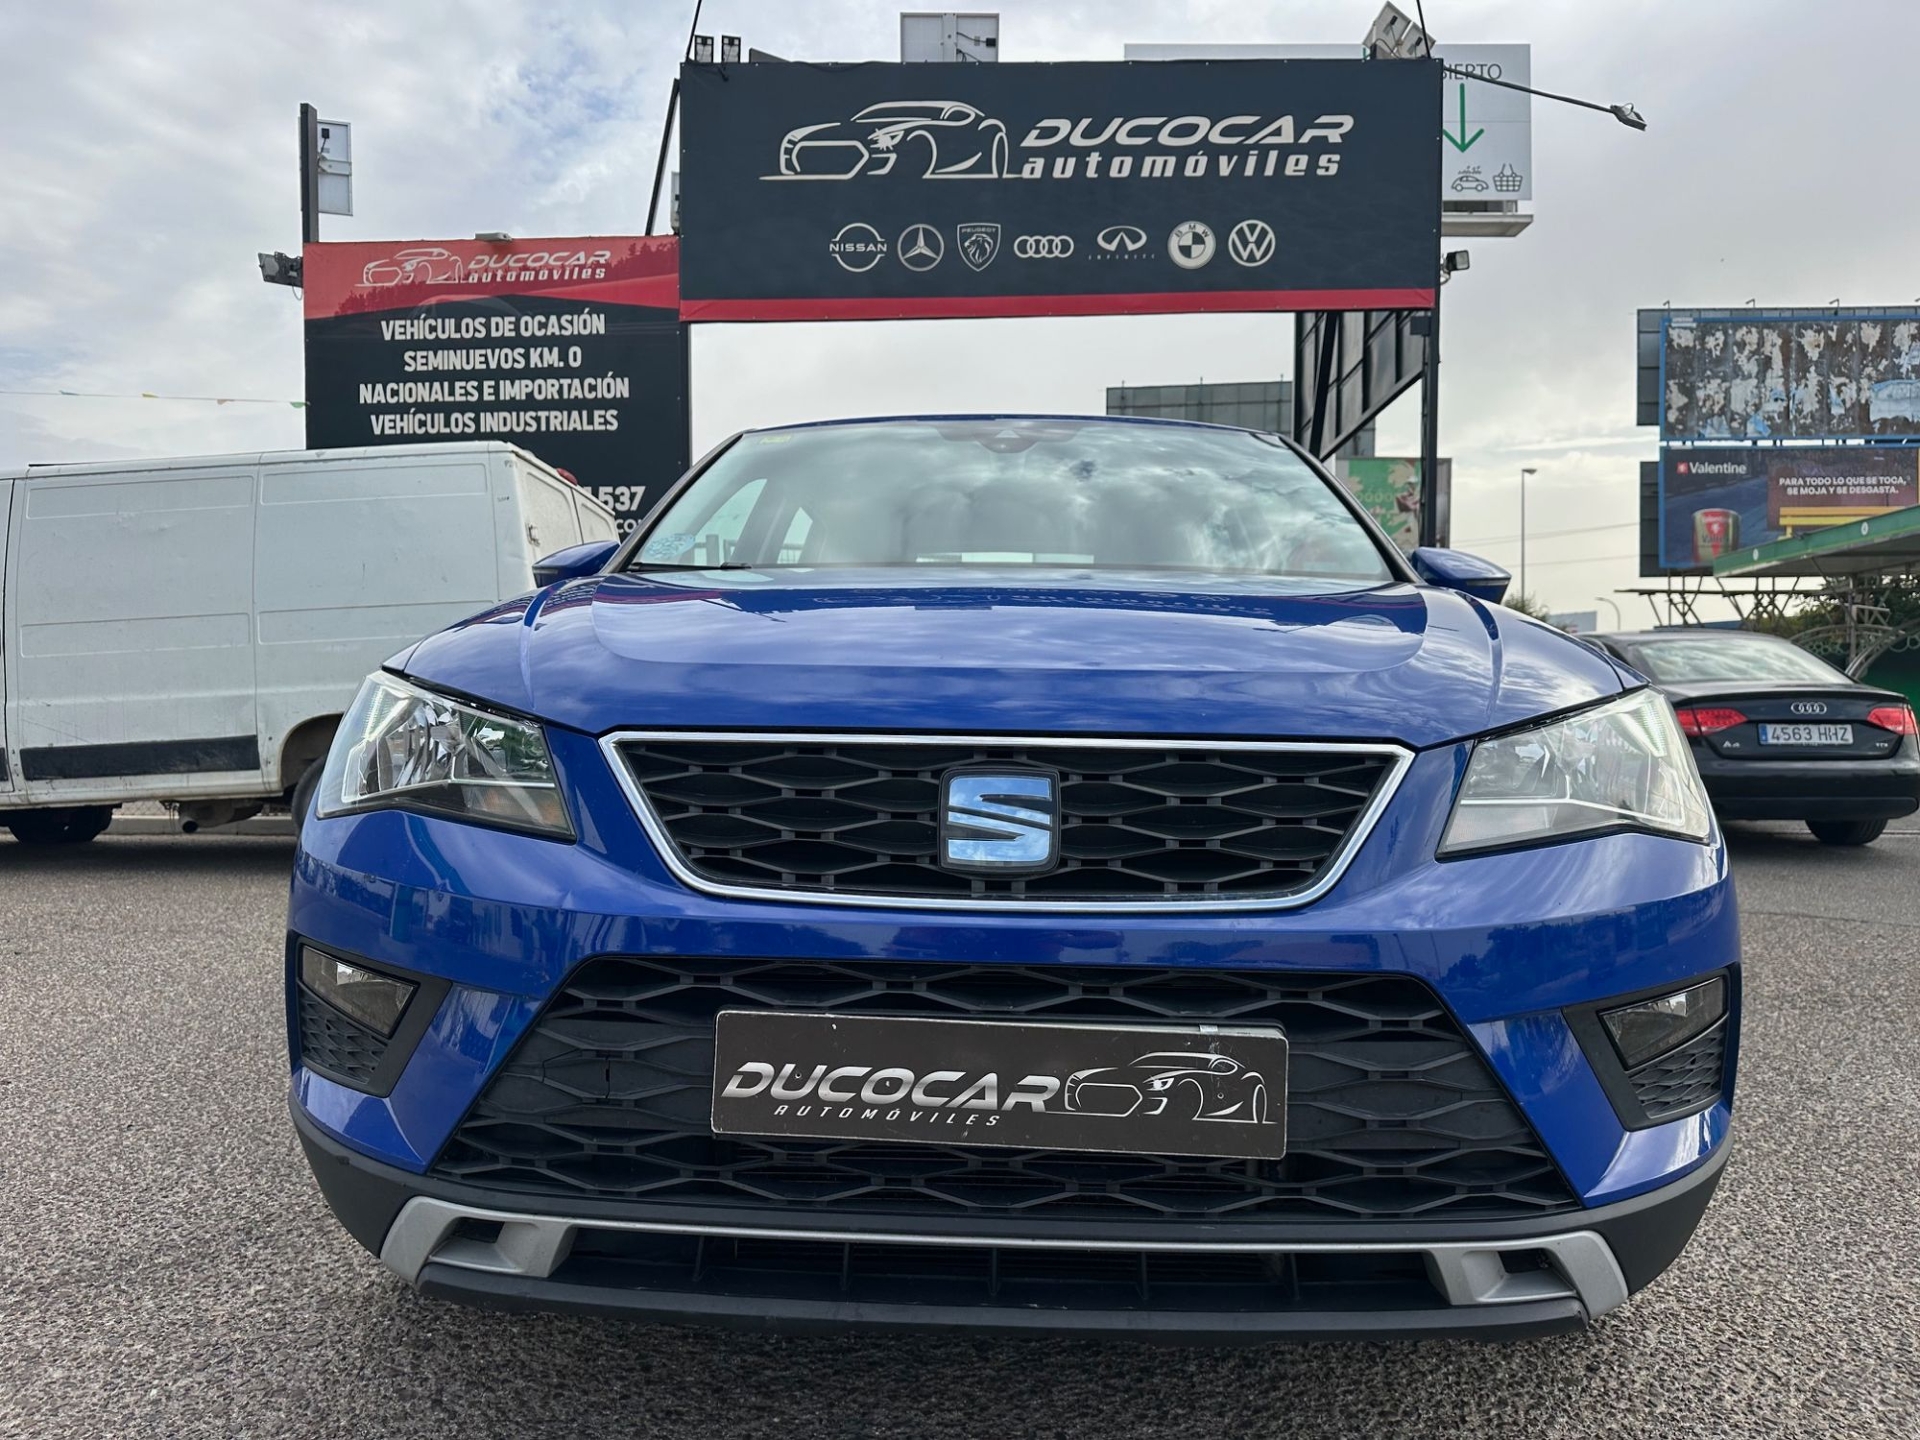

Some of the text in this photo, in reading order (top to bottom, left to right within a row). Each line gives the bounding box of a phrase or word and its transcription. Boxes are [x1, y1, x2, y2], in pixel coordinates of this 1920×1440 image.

[1020, 115, 1354, 147] DUCOCAR
[1022, 150, 1341, 179] automóviles
[468, 250, 611, 269] DUCOCAR
[829, 243, 888, 252] NISSAN
[381, 308, 606, 341] VEHÍCULOS DE OCASIÓN
[404, 348, 525, 372] SEMINUEVOS
[530, 347, 564, 369] KM.
[359, 372, 630, 404] NACIONALES E IMPORTACIÓN
[370, 408, 619, 435] VEHÍCULOS INDUSTRIALES
[1689, 462, 1747, 475] Valentine
[1779, 477, 1805, 486] PARA
[1805, 477, 1832, 486] TODO
[1833, 477, 1845, 485] LO
[1846, 476, 1865, 486] QUE
[1866, 476, 1878, 485] SE
[1787, 487, 1799, 496] SE
[1800, 487, 1828, 495] MOJA
[1829, 487, 1836, 495] Y
[1836, 486, 1848, 495] SE
[1771, 726, 1813, 742] 4563
[1818, 726, 1849, 742] HHZ
[721, 1061, 1061, 1113] DUCOCAR
[773, 1104, 1000, 1127] AUTOMÓVILES
